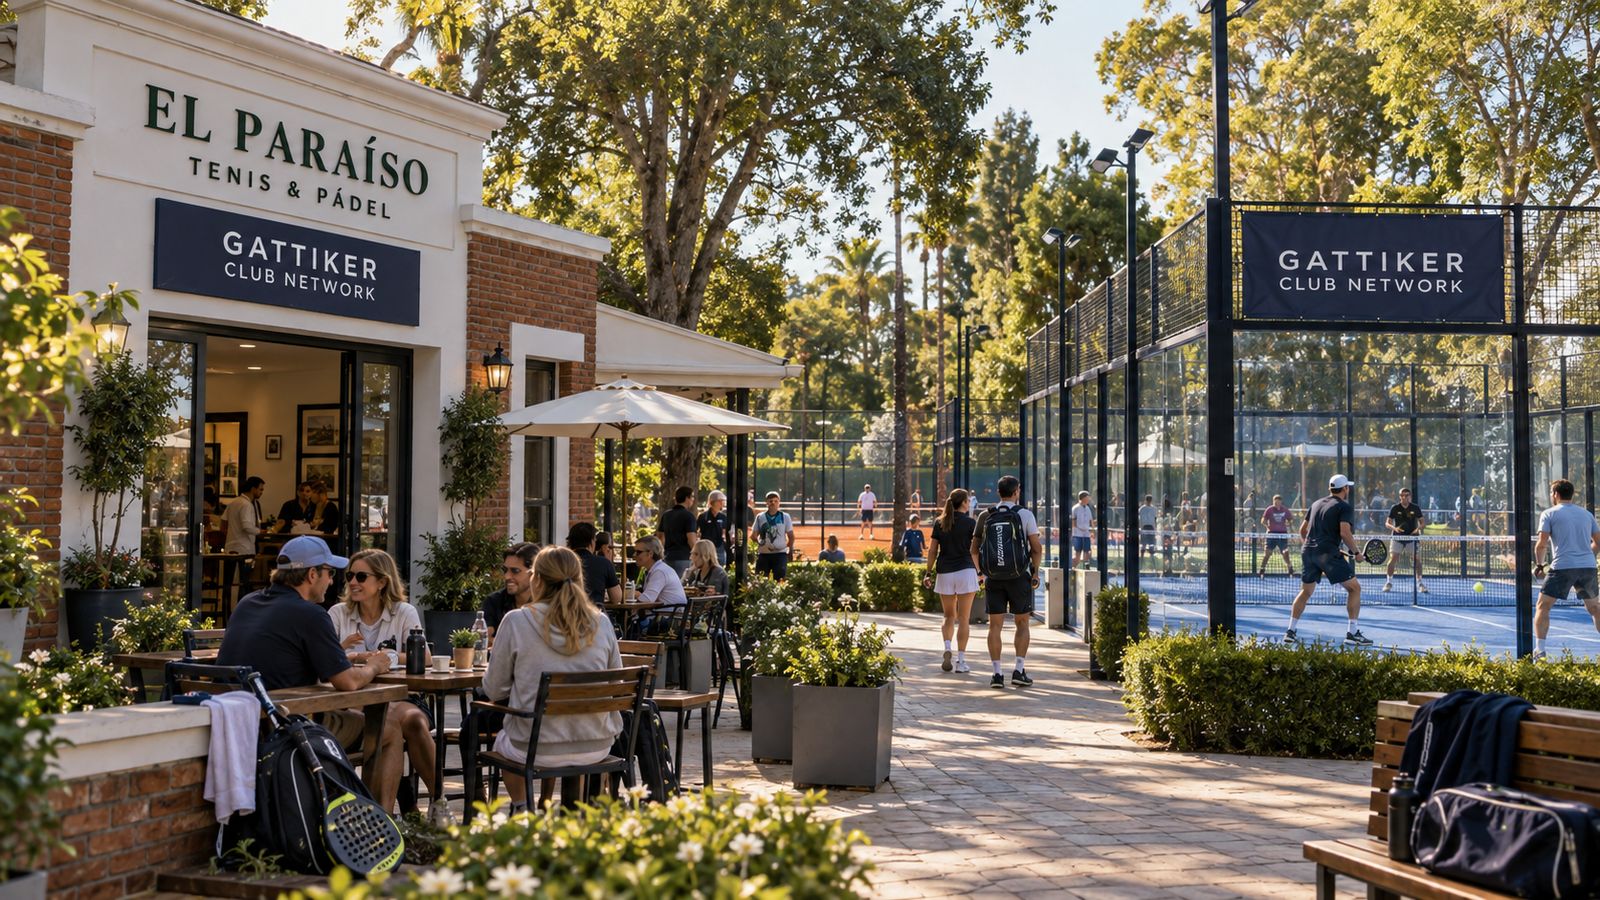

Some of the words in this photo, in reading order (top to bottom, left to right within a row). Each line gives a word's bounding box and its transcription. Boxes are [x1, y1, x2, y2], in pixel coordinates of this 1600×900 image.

[143, 83, 212, 143] EL
[233, 108, 429, 197] PARAÍSO
[188, 156, 271, 192] TENIS
[287, 180, 301, 199] &
[317, 186, 391, 220] PÁDEL
[223, 230, 377, 281] GATTIKER
[1278, 249, 1464, 273] GATTIKER
[224, 261, 275, 284] CLUB
[284, 271, 375, 301] NETWORK
[1279, 276, 1336, 291] CLUB
[1348, 277, 1463, 294] NETWORK
